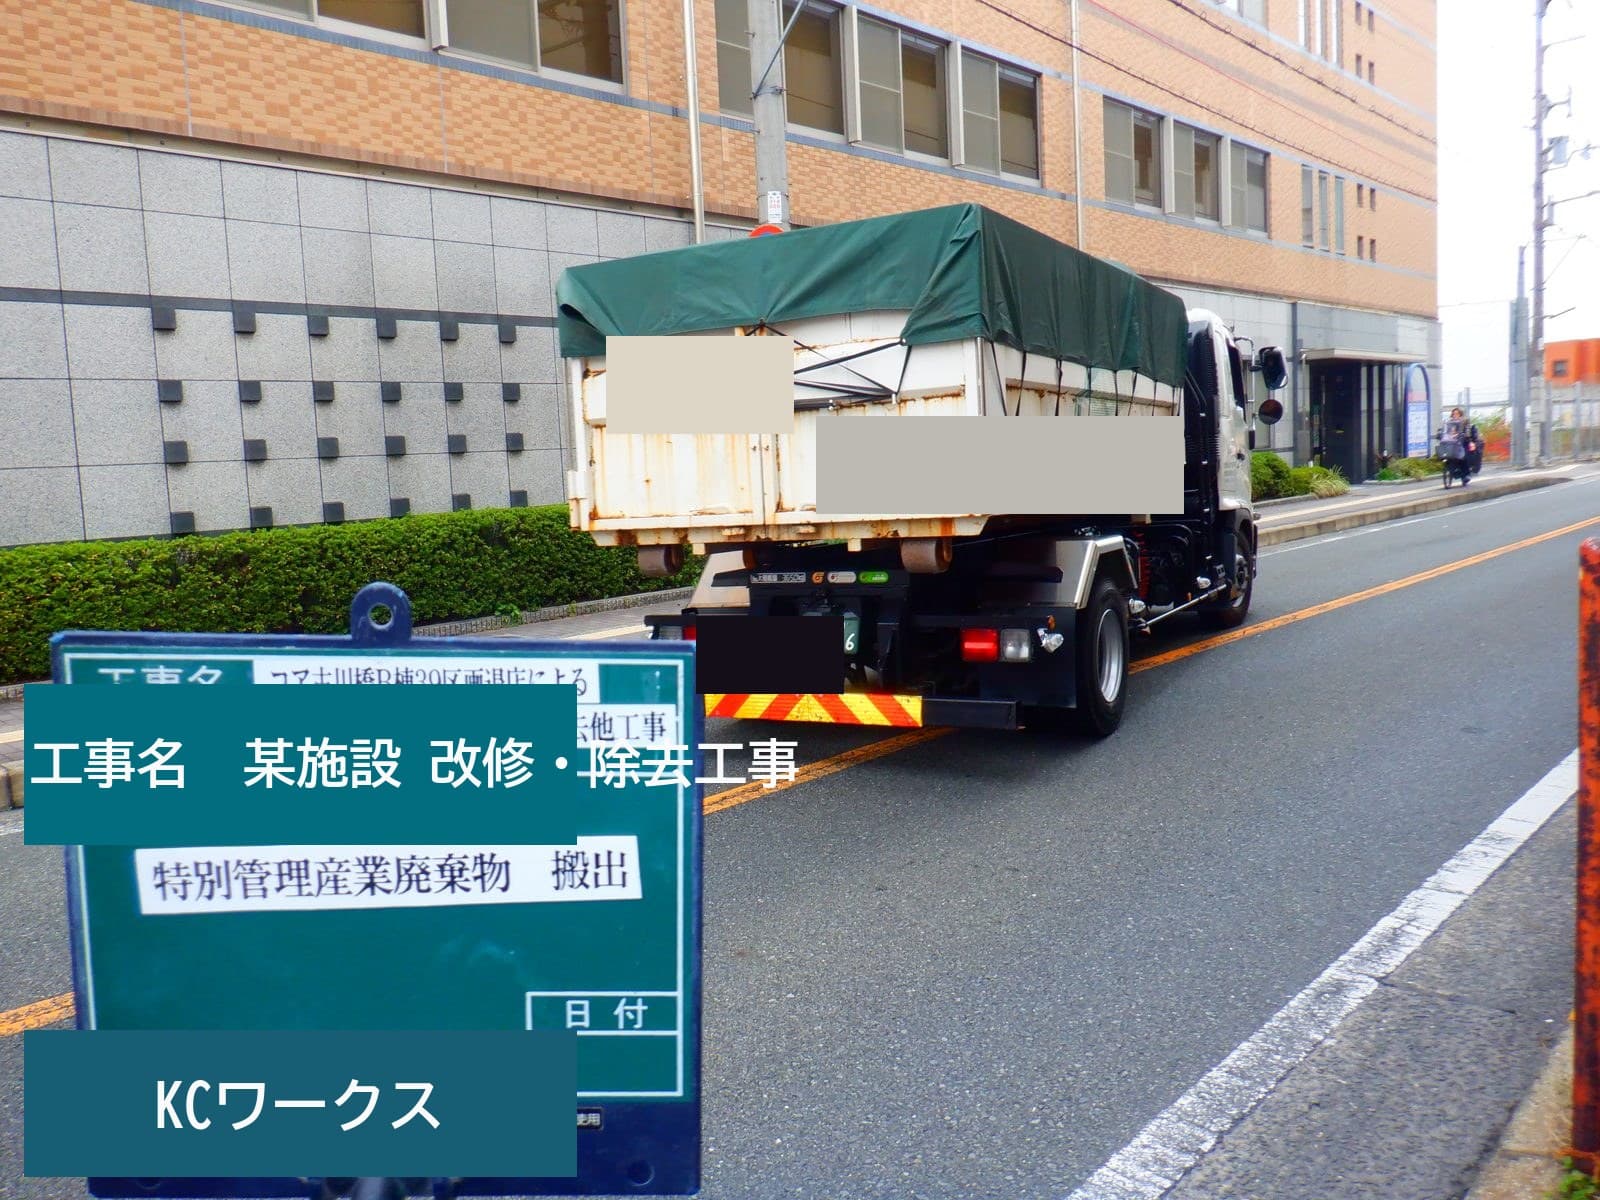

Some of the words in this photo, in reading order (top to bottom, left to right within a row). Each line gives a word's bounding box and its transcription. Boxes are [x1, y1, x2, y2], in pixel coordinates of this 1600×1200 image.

[153, 852, 511, 901] 特別管理産業廃棄物
[551, 849, 627, 891] 搬出
[565, 998, 648, 1029] 日付
